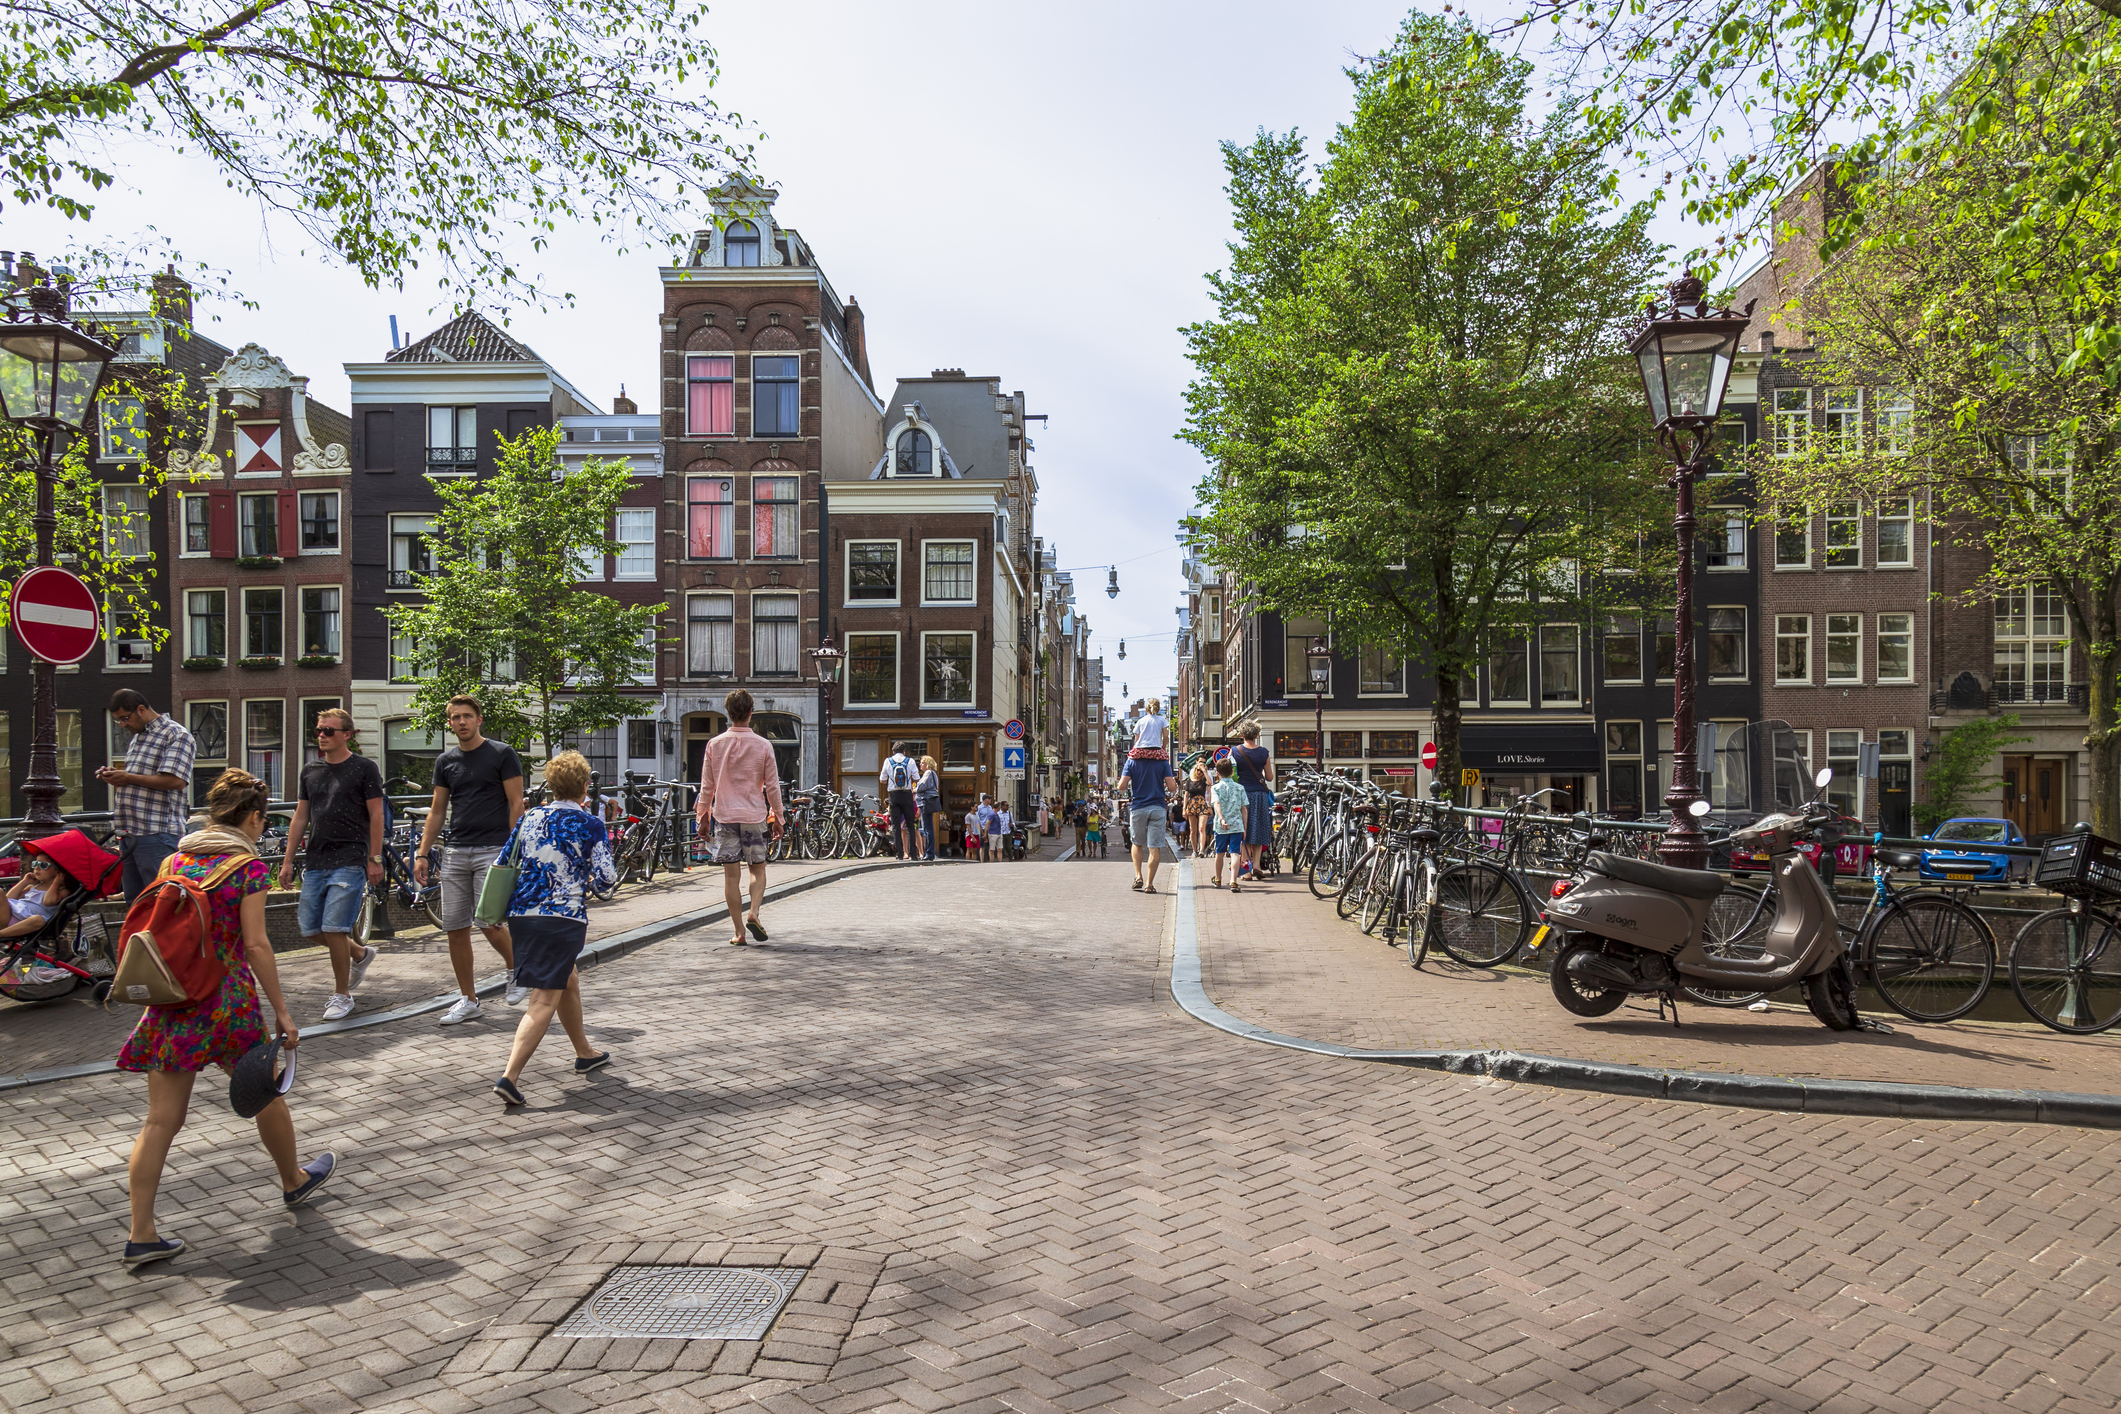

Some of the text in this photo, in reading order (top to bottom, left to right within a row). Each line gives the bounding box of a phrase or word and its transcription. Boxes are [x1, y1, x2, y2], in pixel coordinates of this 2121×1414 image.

[1497, 755, 1545, 763] LOVE Stories
[1466, 771, 1474, 784] R
[1615, 916, 1637, 927] agm
